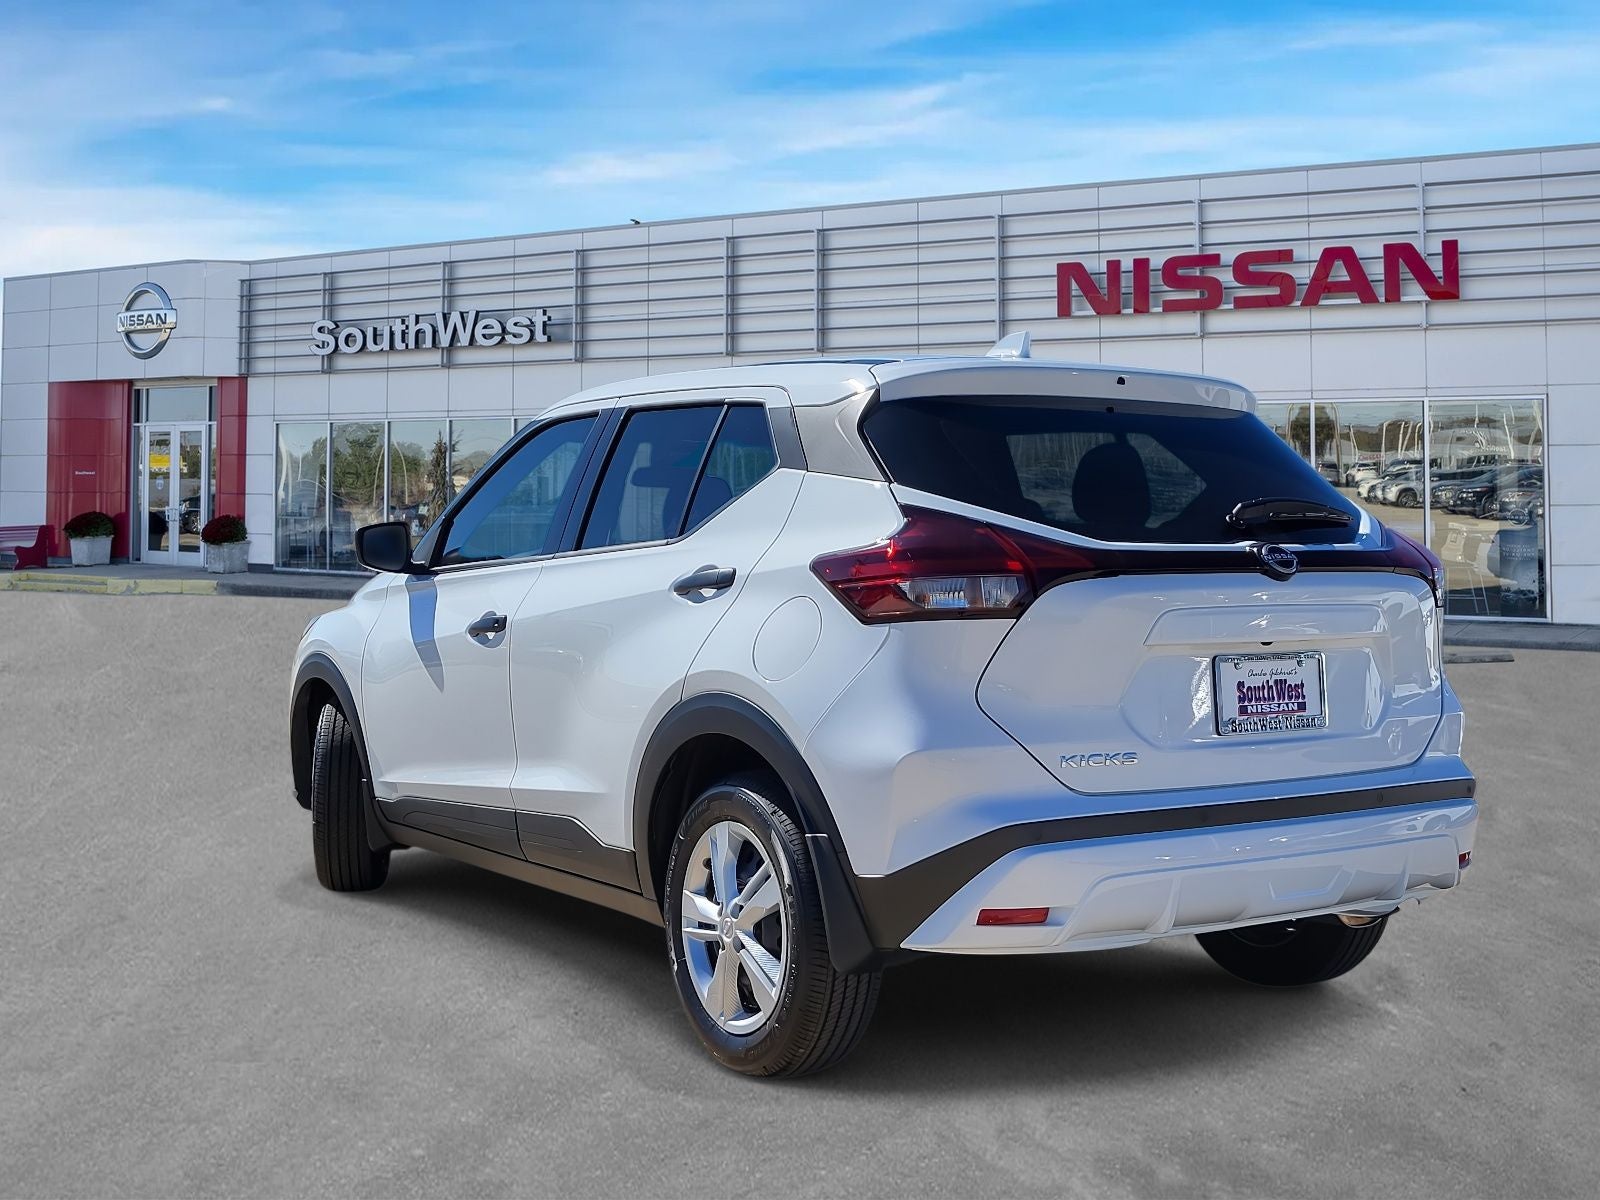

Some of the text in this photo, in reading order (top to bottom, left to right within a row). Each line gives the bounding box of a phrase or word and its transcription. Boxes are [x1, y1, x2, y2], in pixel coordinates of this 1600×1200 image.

[1056, 239, 1461, 318] NISSAN
[118, 312, 167, 328] NISSAN
[309, 309, 552, 356] SouthWest
[1236, 678, 1306, 704] SouthWest
[1247, 703, 1298, 713] NISSAN
[1231, 716, 1317, 733] SouthWest Nissan
[1060, 751, 1139, 768] KICKS
